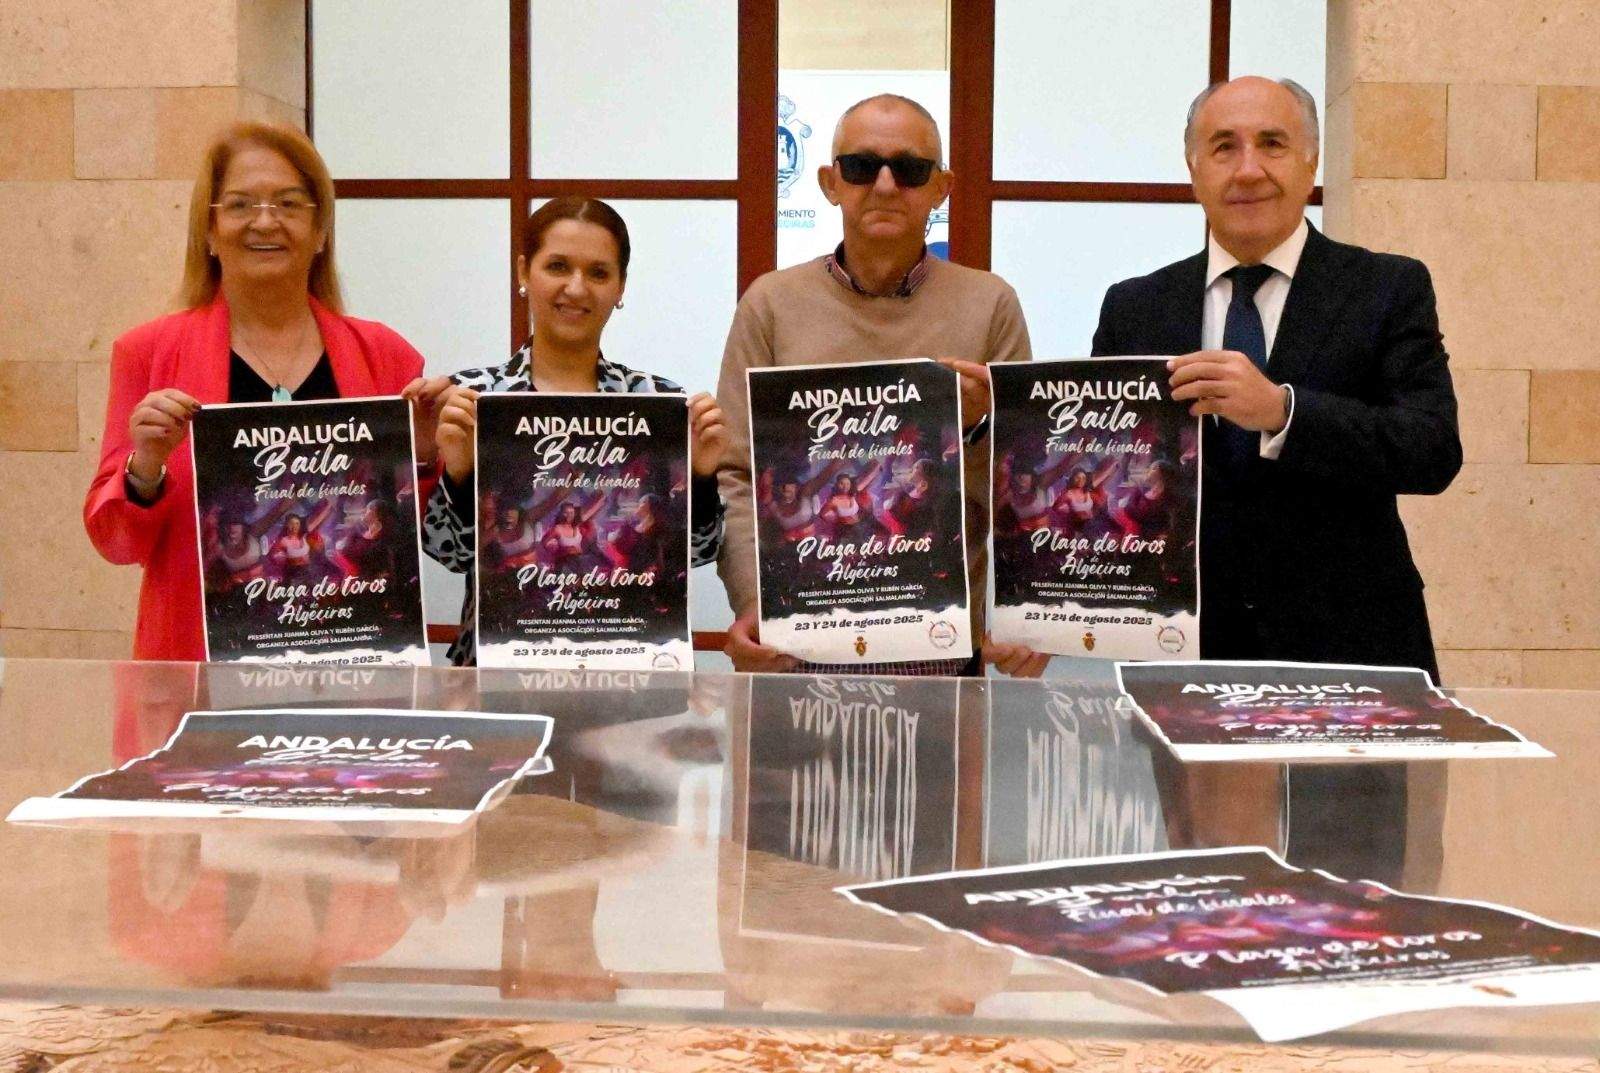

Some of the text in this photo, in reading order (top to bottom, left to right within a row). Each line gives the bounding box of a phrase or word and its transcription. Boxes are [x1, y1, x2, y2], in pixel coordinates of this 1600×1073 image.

[788, 379, 922, 410] ANDALUCÍA
[1030, 375, 1162, 400] ANDALUCÍA
[515, 412, 651, 436] ANDALUCÍA
[808, 404, 901, 444] Baila
[1048, 398, 1142, 434] Baila
[233, 417, 373, 448] ANDALUCÍA
[533, 433, 629, 470] Baila
[807, 440, 913, 463] Final de finales
[1046, 437, 1152, 454] Final de finales
[254, 443, 353, 482] Baila
[254, 480, 366, 502] Final de finales
[532, 471, 640, 490] Final de finales
[796, 535, 932, 564] Plaza de toros
[1030, 528, 1166, 558] Plaza de toros
[516, 564, 655, 595] Plaza de toros
[826, 563, 899, 586] Algeciras
[1060, 556, 1131, 580] Algeciras
[244, 575, 387, 605] Plaza de toros
[277, 603, 354, 627] Algeciras
[547, 591, 621, 615] Algeciras
[795, 615, 923, 631] 23 Y 24 de agosto 2025
[1025, 612, 1039, 620] 23
[1052, 613, 1066, 621] 24
[1069, 613, 1081, 622] de
[1083, 615, 1121, 624] agosto
[1123, 616, 1152, 625] 2025
[352, 655, 382, 664] 2025
[513, 648, 529, 656] 23
[542, 648, 557, 656] 24
[560, 648, 573, 656] de
[575, 649, 613, 657] agosto
[616, 647, 646, 655] 2025
[1181, 682, 1382, 694] ANDALUCÍA
[237, 734, 473, 750] ANDALUCÍA
